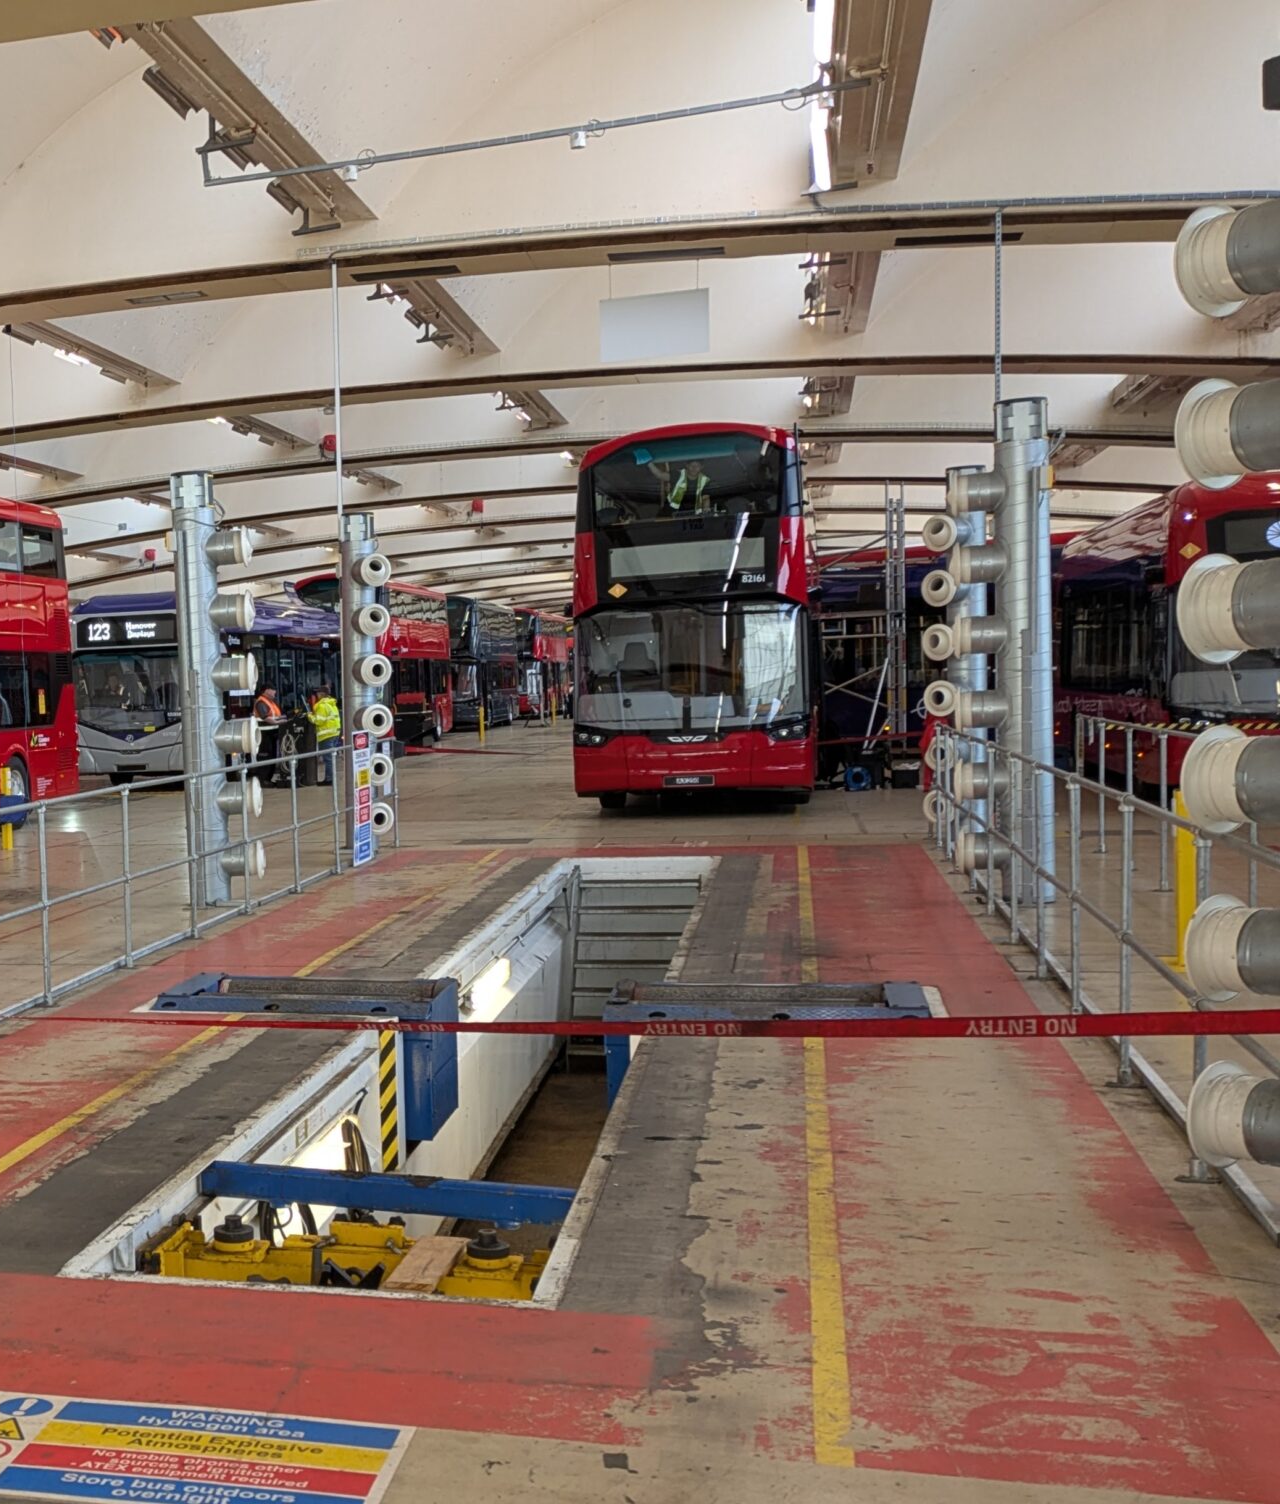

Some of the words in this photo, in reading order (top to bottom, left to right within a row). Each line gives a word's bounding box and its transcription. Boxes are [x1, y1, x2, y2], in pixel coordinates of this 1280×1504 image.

[88, 623, 111, 641] 123
[125, 621, 156, 631] Hanover
[644, 1023, 707, 1036] ENTRY
[714, 1023, 742, 1036] NO
[965, 1018, 1037, 1036] ENTRY
[1044, 1018, 1077, 1035] NO
[137, 1414, 248, 1434] Hydrogen
[255, 1425, 306, 1439] area
[171, 1409, 286, 1429] WARNING
[101, 1426, 202, 1443] Potential
[208, 1436, 325, 1455] Explosive
[126, 1438, 283, 1460] Atmospheres
[91, 1449, 116, 1458] No
[121, 1451, 179, 1464] mobile
[183, 1456, 250, 1471] phones
[255, 1464, 304, 1475] other
[109, 1457, 179, 1470] sources
[183, 1462, 204, 1472] of
[204, 1464, 275, 1478] ignition
[79, 1460, 129, 1473] ATEX
[131, 1466, 227, 1481] equipment
[230, 1474, 310, 1488] required
[60, 1472, 127, 1488] Store
[130, 1475, 177, 1491] bus
[182, 1483, 296, 1503] outdoors
[111, 1487, 231, 1504] overnight
